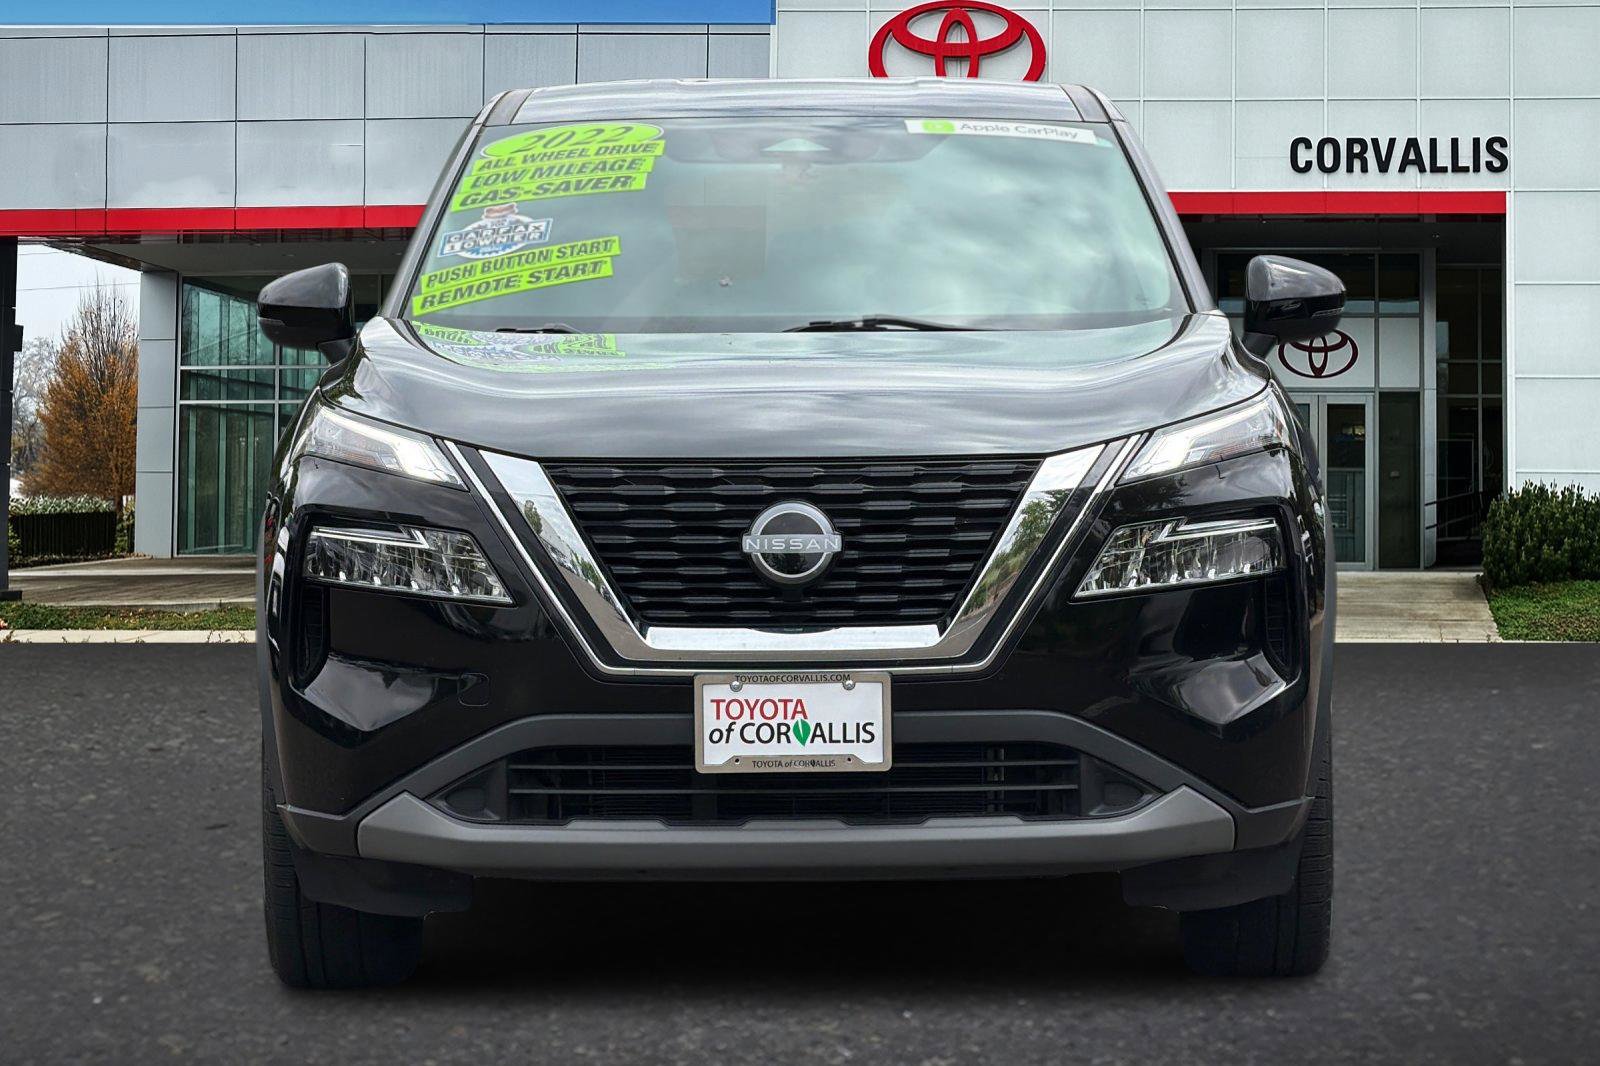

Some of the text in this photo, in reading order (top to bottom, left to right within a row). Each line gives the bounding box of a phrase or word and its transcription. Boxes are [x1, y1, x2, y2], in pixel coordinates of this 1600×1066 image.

[511, 125, 636, 155] 2022
[959, 122, 1079, 140] Apple CarPlay
[477, 141, 658, 173] ALL WHEEL DRIVE
[1290, 136, 1509, 174] CORVALLIS
[469, 156, 647, 190] LOW MILEAGE
[459, 175, 636, 207] GAS-SAVER
[460, 231, 543, 249] OWNER
[425, 238, 616, 288] PUSH BUTTON START
[419, 260, 607, 310] REMOTE START
[746, 538, 838, 550] NISSAN
[735, 673, 851, 683] TOYOTAOFCORVALLIS.COM
[710, 698, 808, 721] TOYOTA
[708, 721, 736, 745] of
[751, 760, 783, 769] TOYOTA
[784, 760, 794, 769] of
